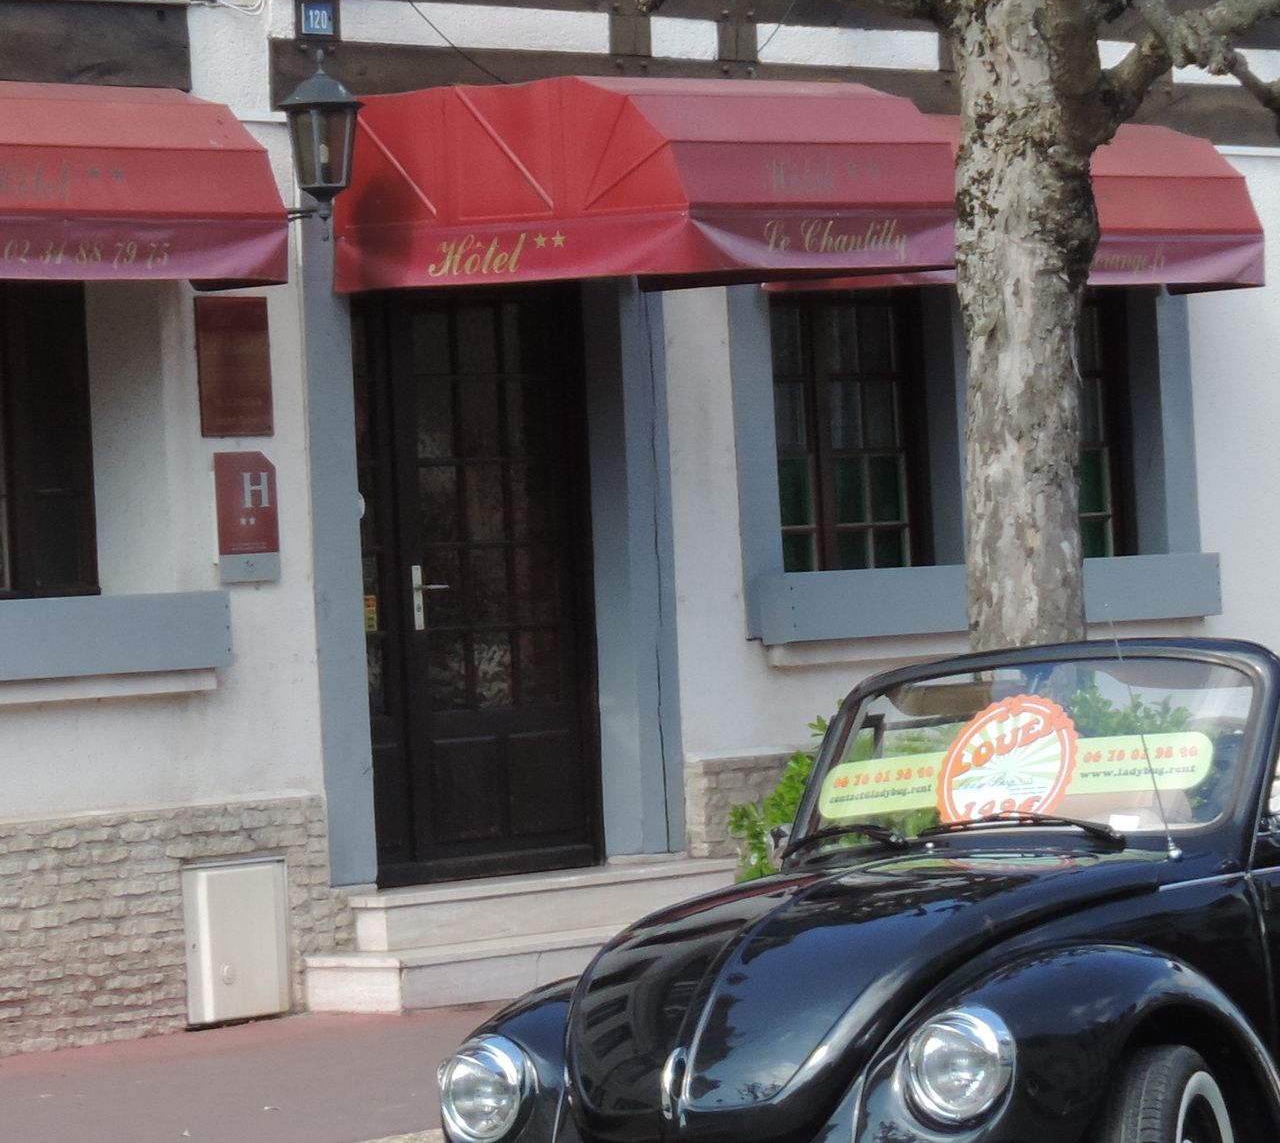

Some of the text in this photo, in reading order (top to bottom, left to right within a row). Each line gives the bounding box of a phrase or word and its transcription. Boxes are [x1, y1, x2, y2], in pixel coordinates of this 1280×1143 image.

[308, 9, 328, 29] 120
[4, 239, 30, 264] 02
[74, 239, 105, 264] 88
[111, 241, 138, 269] 79
[428, 232, 528, 278] Hôtel
[763, 218, 908, 262] Le Chantilly
[241, 472, 271, 508] H
